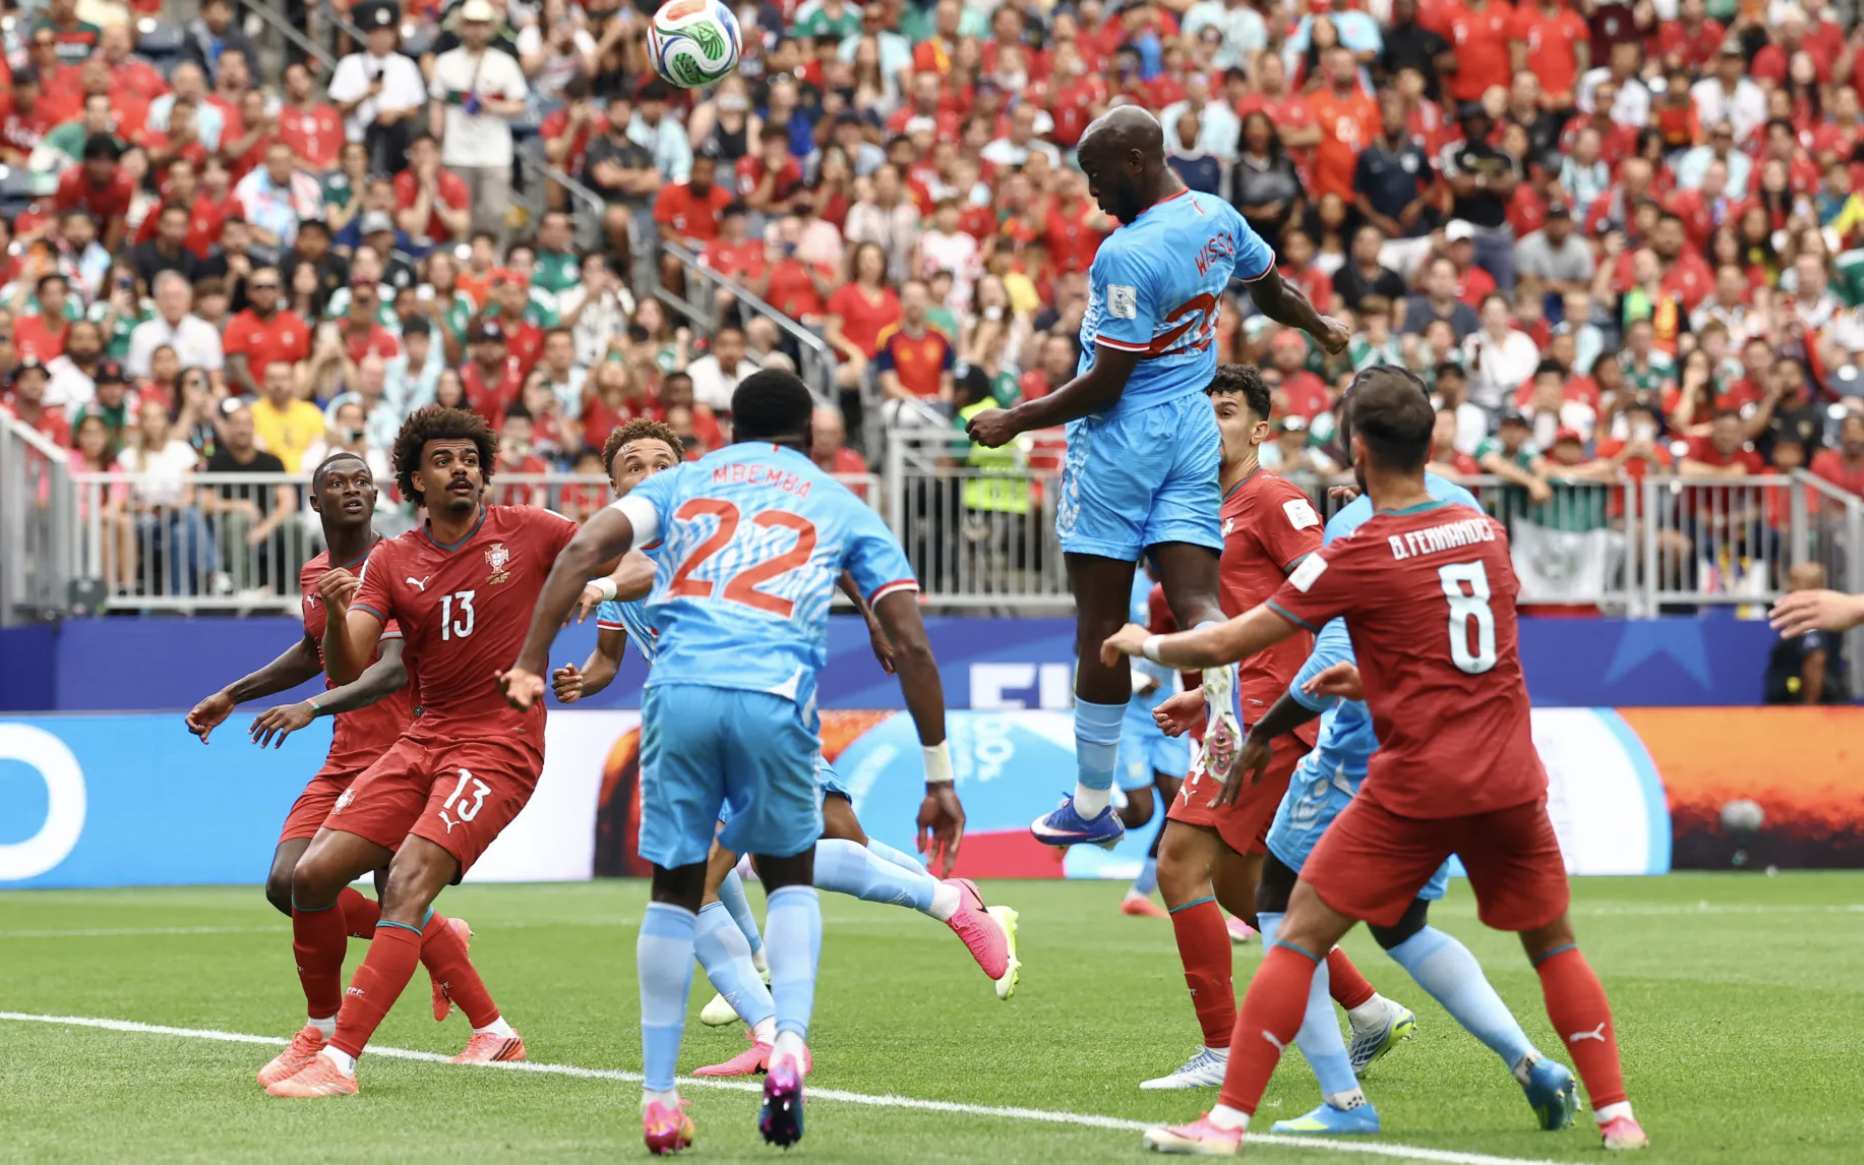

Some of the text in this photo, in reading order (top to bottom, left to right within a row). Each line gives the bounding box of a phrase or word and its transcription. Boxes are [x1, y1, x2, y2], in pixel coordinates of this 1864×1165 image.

[1194, 232, 1235, 278] WISSA
[712, 463, 812, 499] MBEMBA
[664, 498, 818, 619] 22
[438, 587, 476, 641] 13
[1437, 559, 1497, 674] 8
[443, 768, 492, 822] 13
